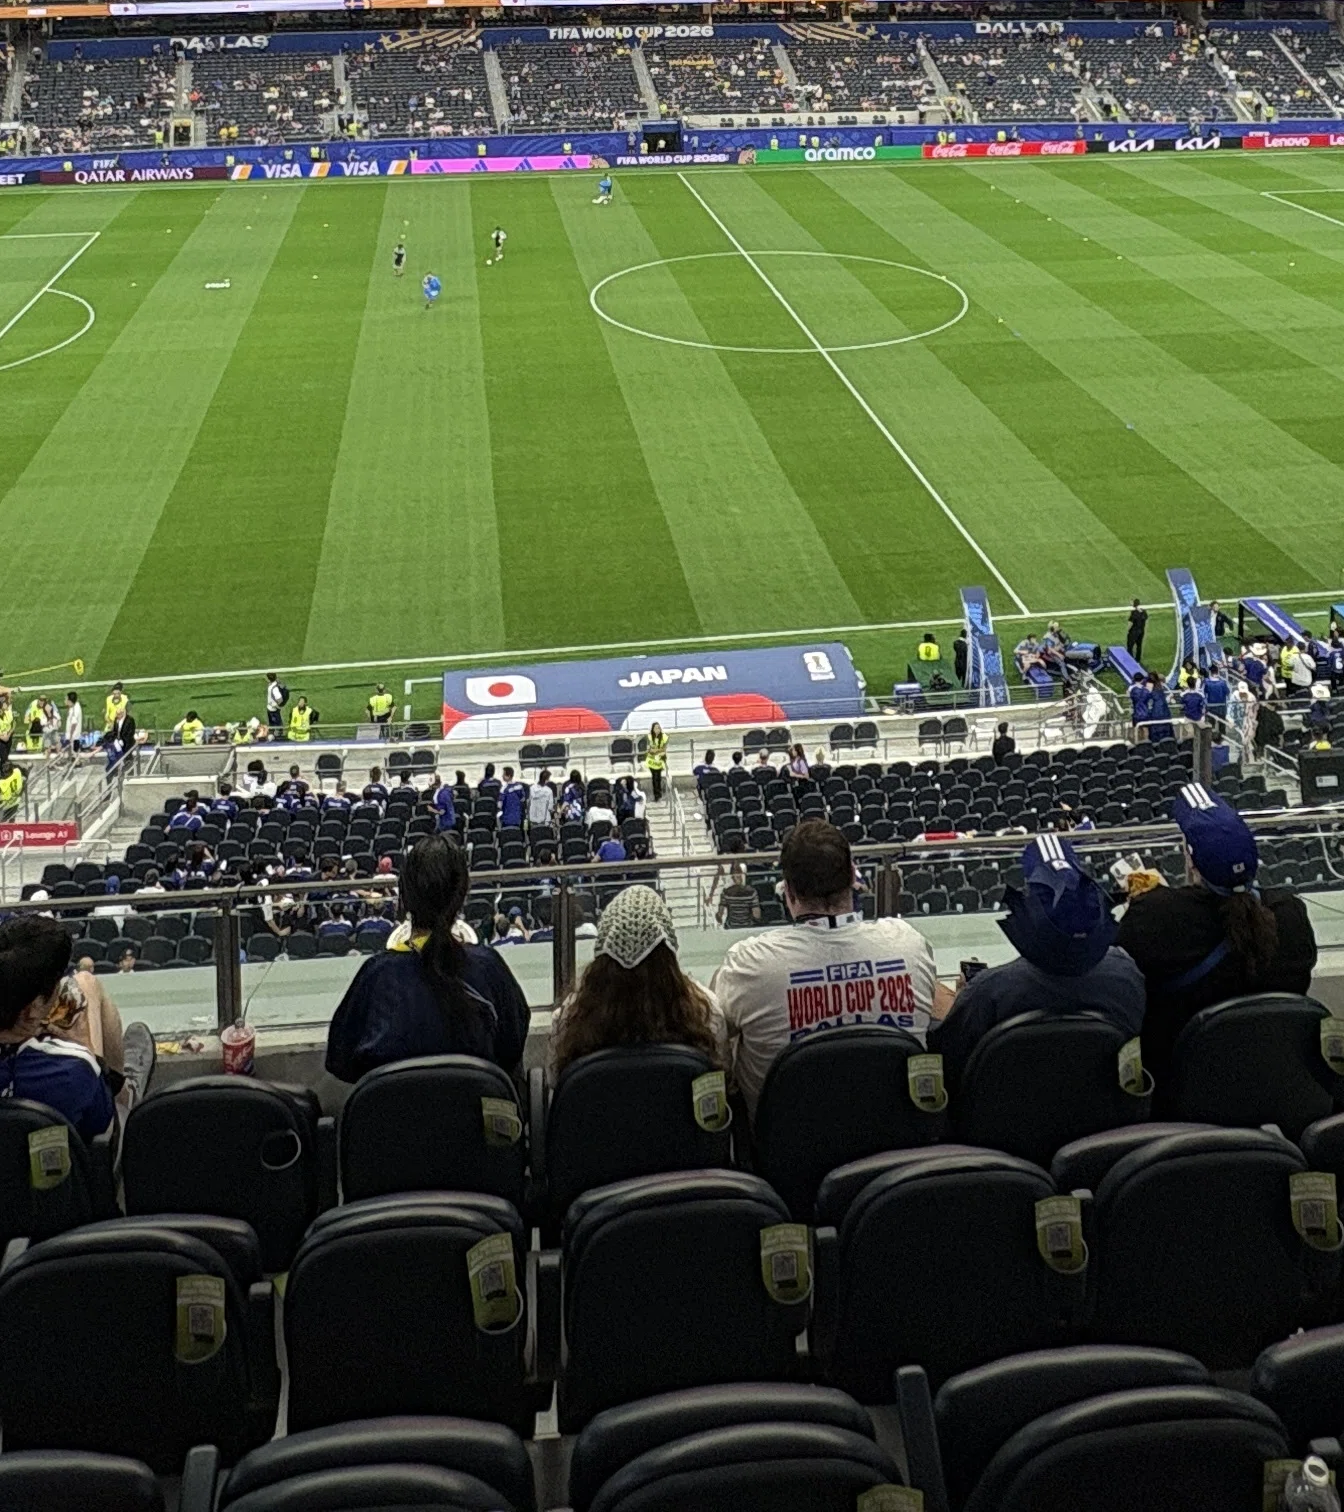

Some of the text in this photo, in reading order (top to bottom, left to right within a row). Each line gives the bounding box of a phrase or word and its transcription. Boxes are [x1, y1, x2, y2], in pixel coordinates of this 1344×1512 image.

[549, 25, 714, 41] FIFA WORLD CUP 2026
[170, 35, 268, 50] DALAS
[1107, 139, 1155, 153] KIA
[1175, 136, 1221, 151] KIA
[1265, 133, 1311, 148] Lenovo
[617, 153, 729, 166] FIFA WORLD CUP 2026
[804, 146, 876, 163] aramco
[74, 167, 195, 184] QATAR AIRWAYS
[264, 163, 303, 179] VISA
[340, 161, 380, 177] VISA
[618, 664, 728, 688] JAPAN
[829, 963, 872, 981] FIFA
[787, 974, 915, 1031] WORLD CUP 2026
[790, 1014, 915, 1041] ALLAS
